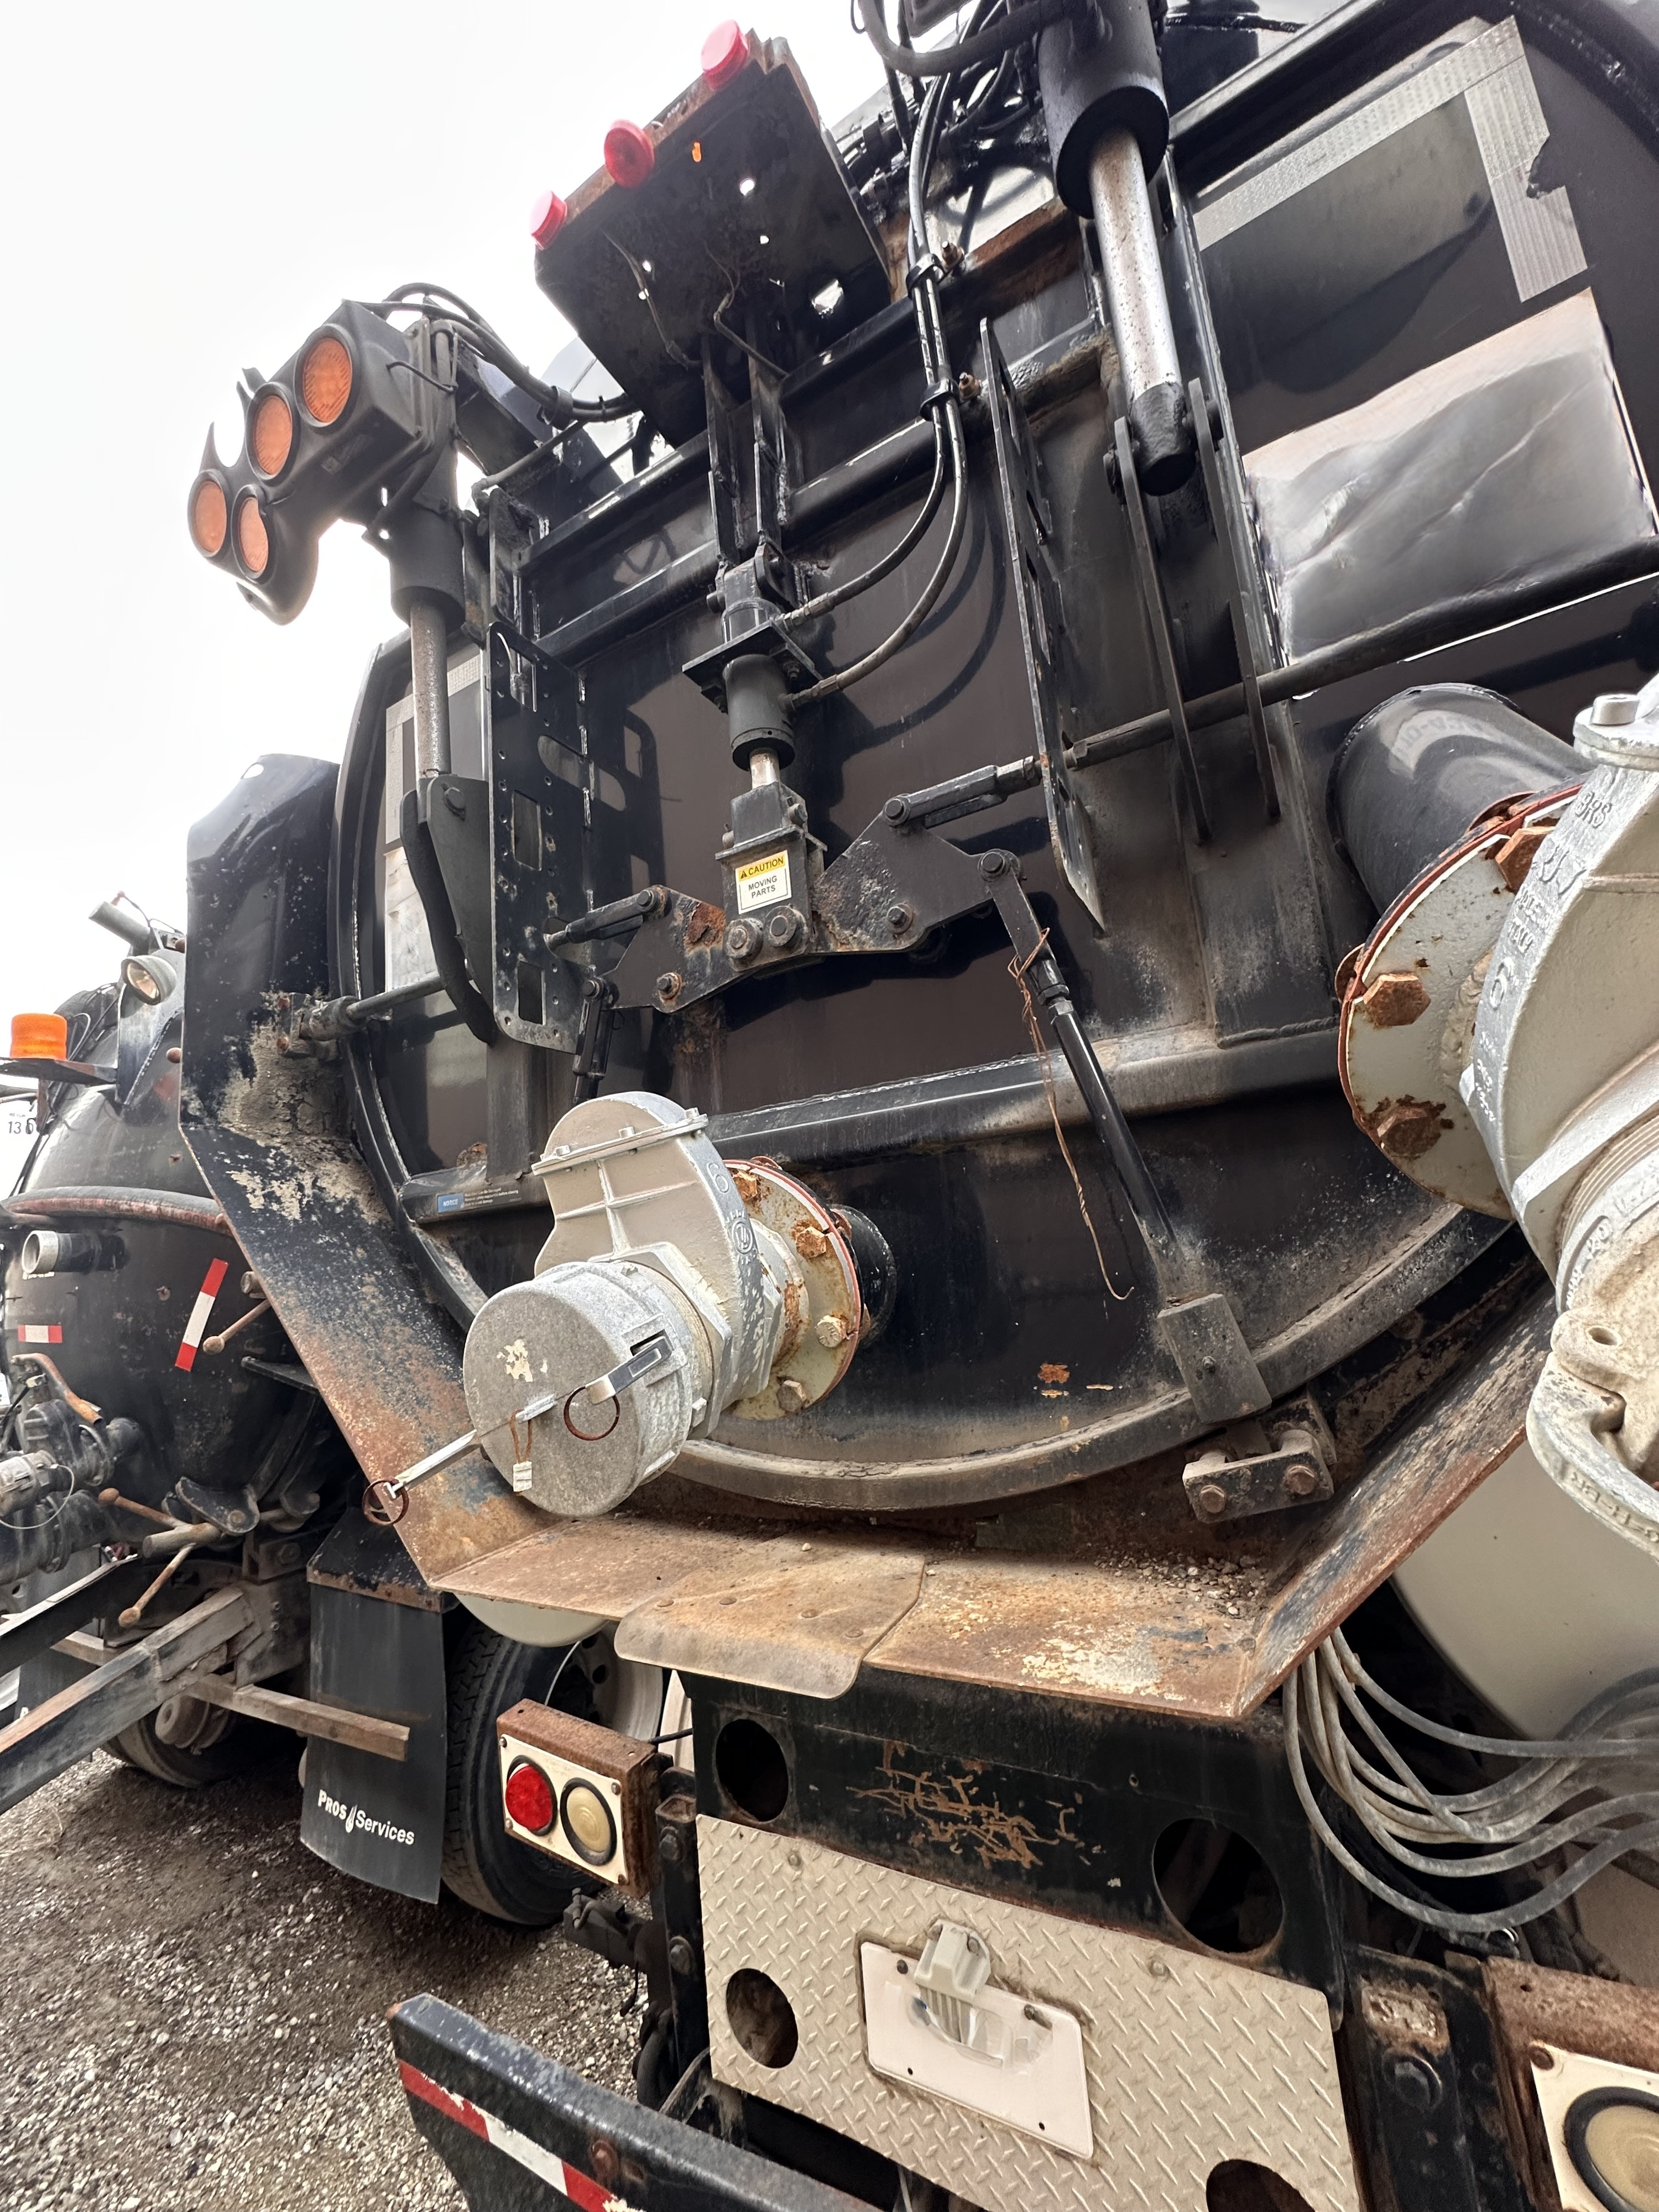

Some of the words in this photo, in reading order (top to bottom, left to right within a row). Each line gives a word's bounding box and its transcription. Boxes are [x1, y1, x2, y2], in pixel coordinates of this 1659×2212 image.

[748, 857, 784, 875] CAUTION
[748, 875, 778, 891] MOVING
[751, 885, 776, 899] PARTS
[706, 1162, 730, 1193] 6
[443, 1198, 458, 1207] NOTICE
[317, 1789, 347, 1820] PROS
[355, 1809, 415, 1845] Services
